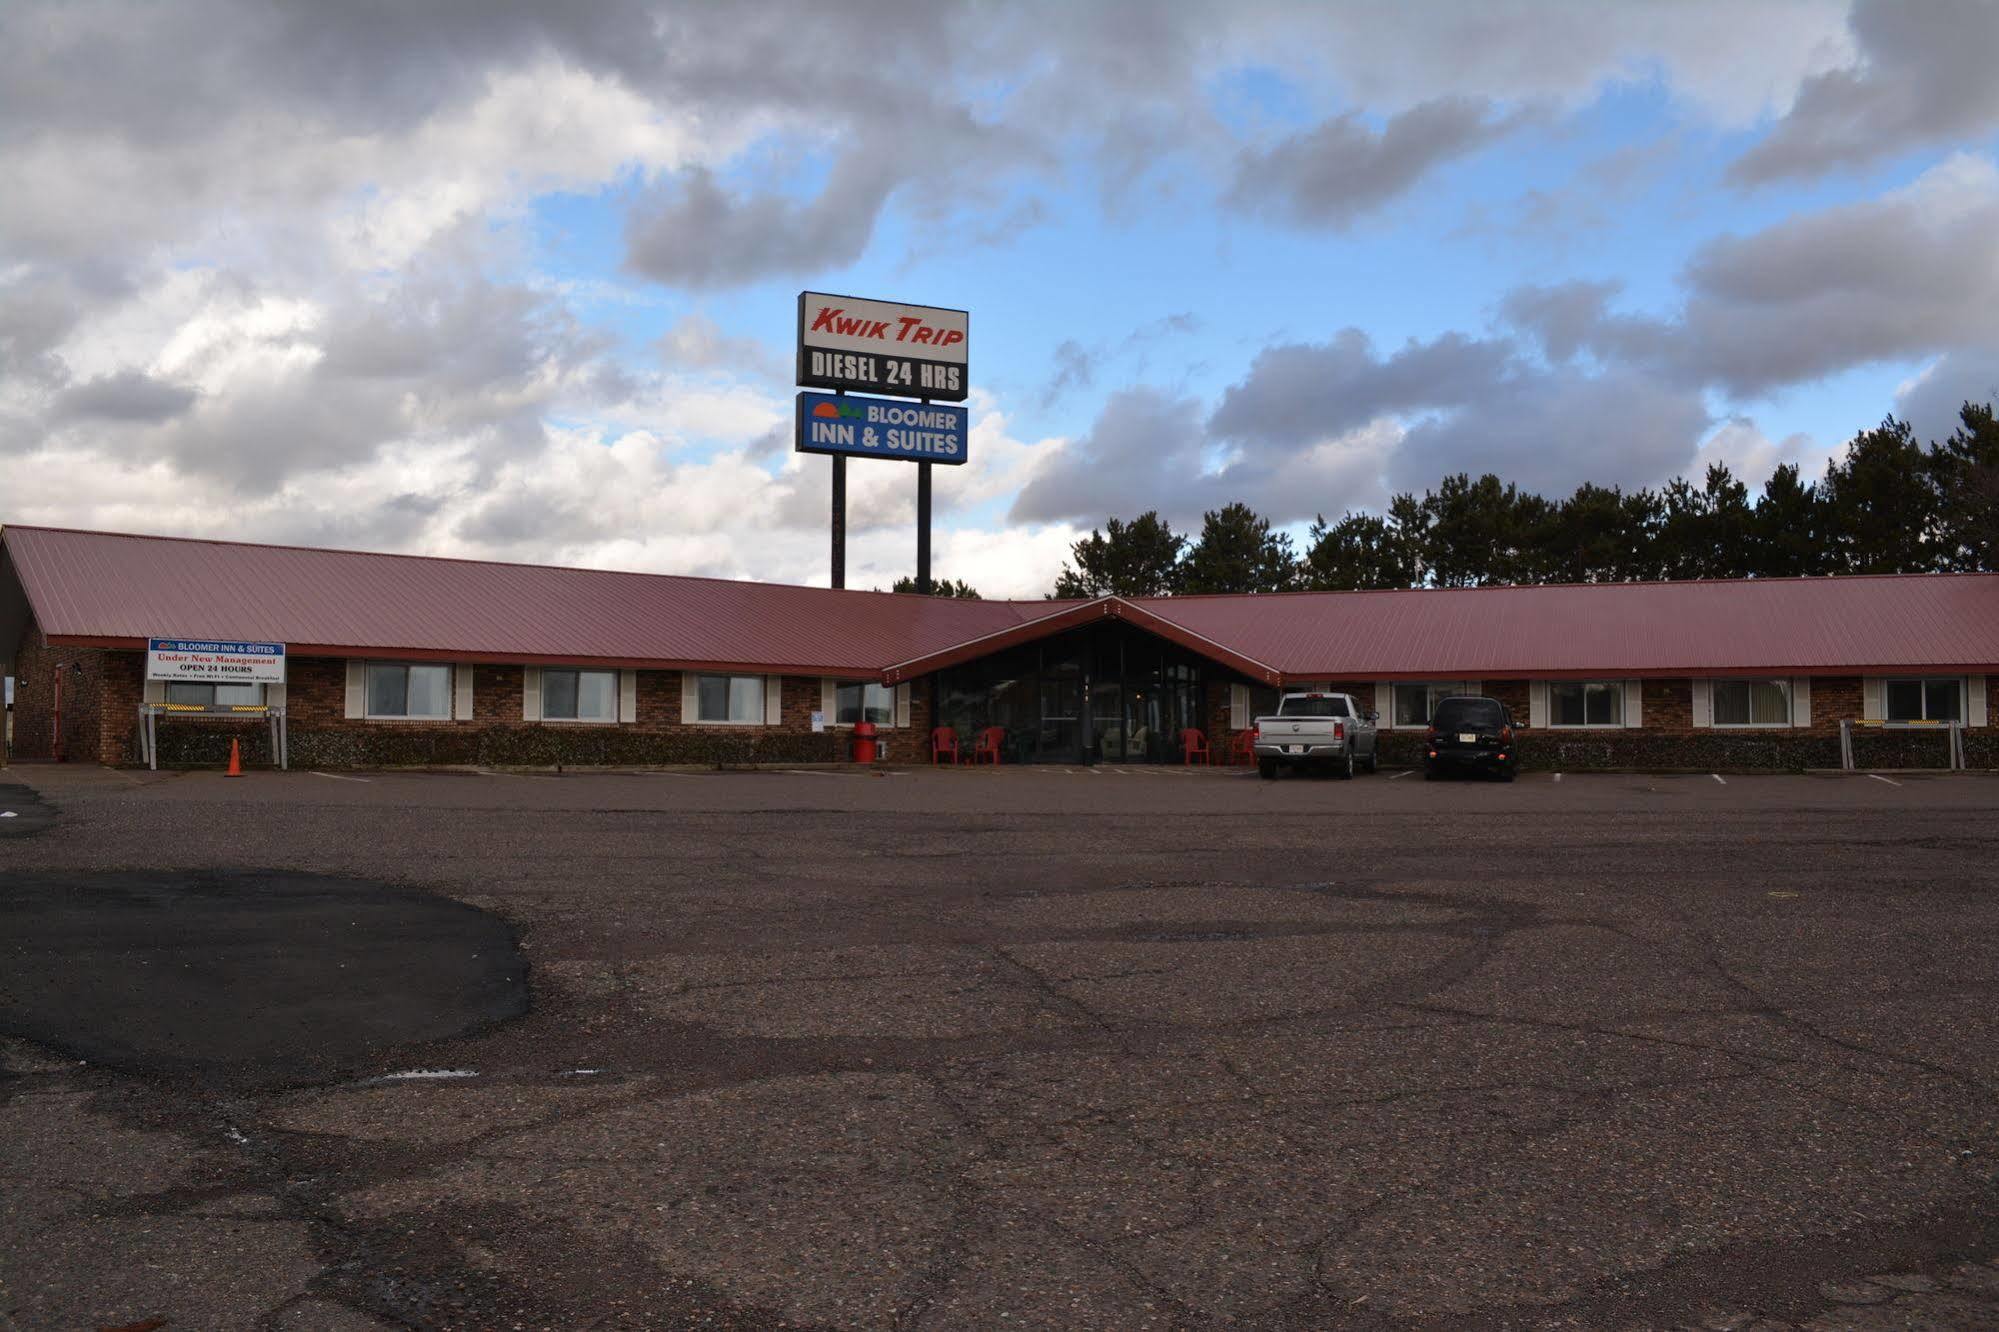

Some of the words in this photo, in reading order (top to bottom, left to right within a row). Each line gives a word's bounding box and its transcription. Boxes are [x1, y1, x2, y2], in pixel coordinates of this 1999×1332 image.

[812, 351, 878, 382] DIESEL
[886, 360, 912, 385] 24
[920, 363, 960, 391] HRS
[868, 406, 957, 430] BLOOMER
[812, 422, 854, 445] INN
[862, 427, 879, 447] &
[887, 429, 958, 455] SUITES
[178, 642, 220, 652] BLOOMER
[221, 643, 236, 653] INN
[238, 644, 245, 653] &
[247, 645, 275, 654] SUITES
[158, 653, 188, 662] Under
[191, 654, 213, 662] New
[216, 655, 276, 665] Management
[180, 664, 205, 672] OPEN
[207, 664, 218, 672] 24
[221, 665, 253, 673] HOURS
